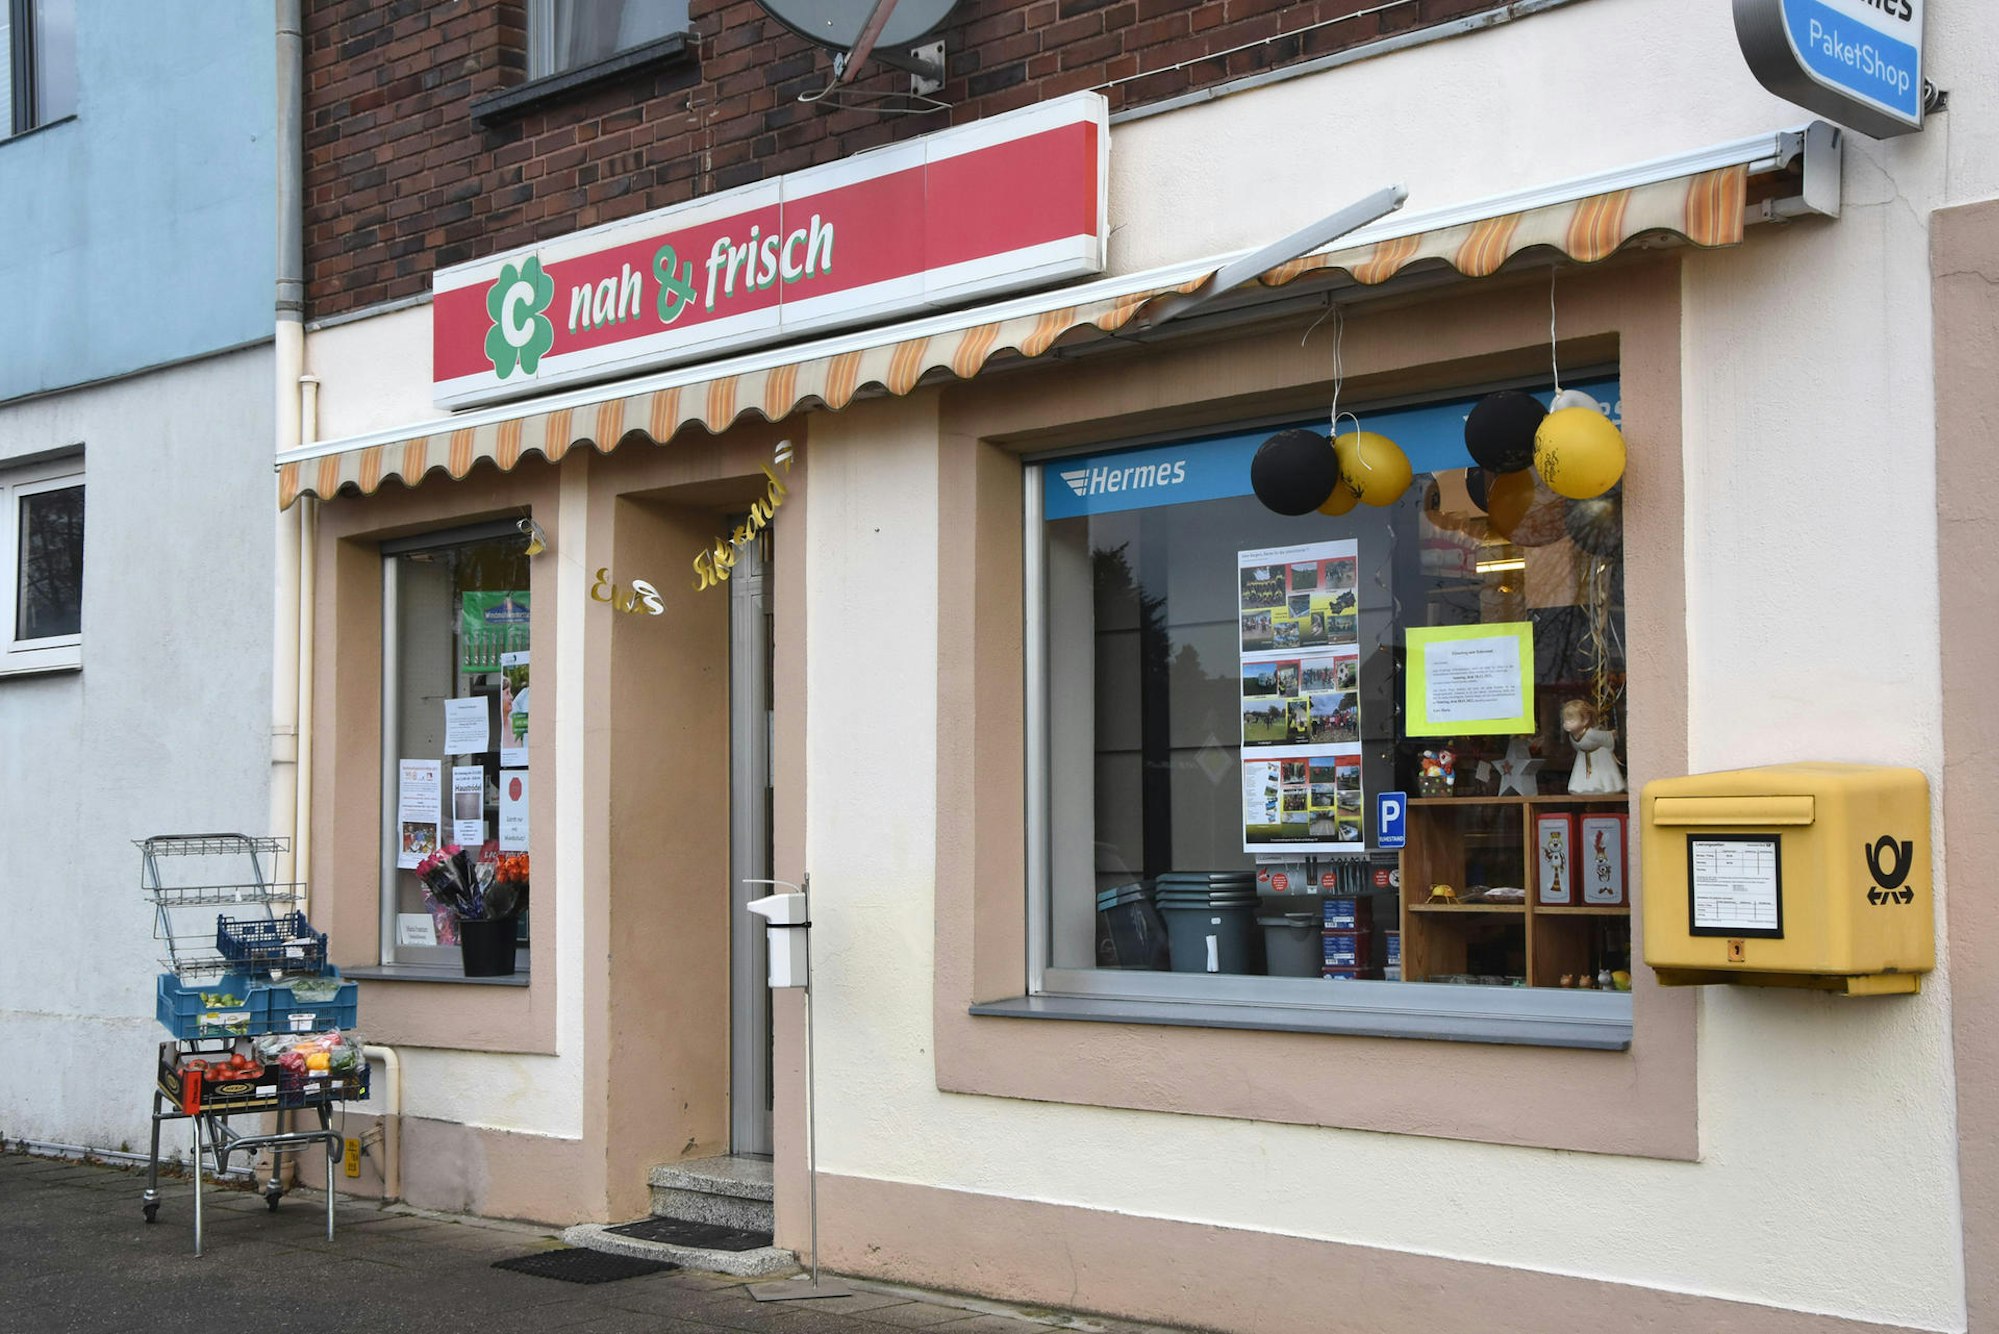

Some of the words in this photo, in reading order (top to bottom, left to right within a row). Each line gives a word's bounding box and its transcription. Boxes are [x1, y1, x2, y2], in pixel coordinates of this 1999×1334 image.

[1809, 19, 1910, 94] PaketShop
[567, 262, 642, 334] nah
[652, 244, 697, 324] &
[704, 213, 834, 312] frisch
[1090, 460, 1187, 495] Hermes
[1382, 801, 1400, 833] P
